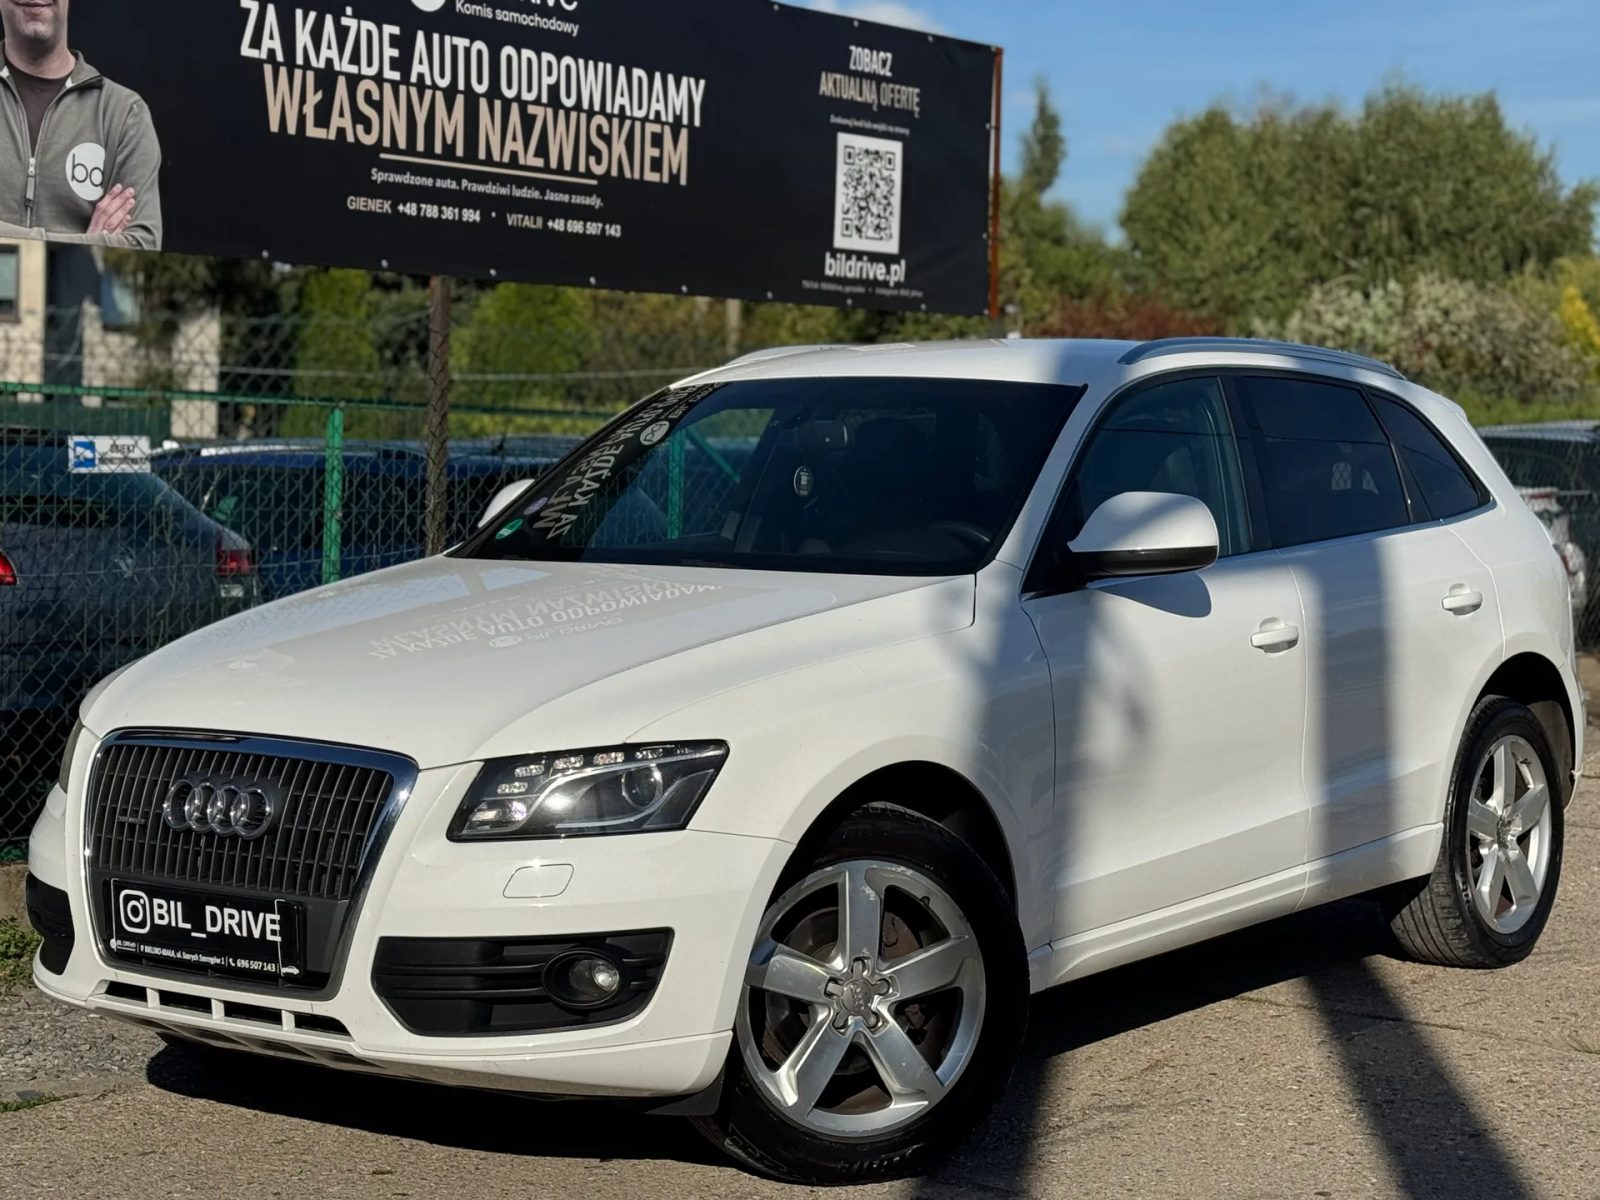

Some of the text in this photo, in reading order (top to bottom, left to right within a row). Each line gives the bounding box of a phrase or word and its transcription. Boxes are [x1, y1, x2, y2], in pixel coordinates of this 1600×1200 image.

[455, 0, 493, 19] Komis
[495, 8, 579, 37] samochodowy
[240, 0, 706, 127] ZA KAŻDE AUTO ODPOWIADAMY
[849, 45, 893, 77] ZOBACZ
[819, 71, 920, 119] AKTUALNĄ OFERTĘ
[263, 63, 688, 186] WŁASNYM NAZWISKIEM
[371, 168, 604, 210] Sprawdzone auta. Prawdziwi ludzie. Jasne zasady.
[347, 196, 392, 213] GIENEK
[397, 202, 417, 216] +48
[420, 204, 439, 219] 788
[441, 206, 459, 220] 361
[462, 208, 481, 222] 994
[547, 218, 566, 232] +48
[566, 219, 584, 234] 696
[585, 221, 603, 236] 507
[605, 223, 622, 238] 143
[824, 251, 906, 288] bildrive.pl
[152, 898, 282, 941] BIL_DRIVE
[236, 957, 276, 973] 696 507 143
